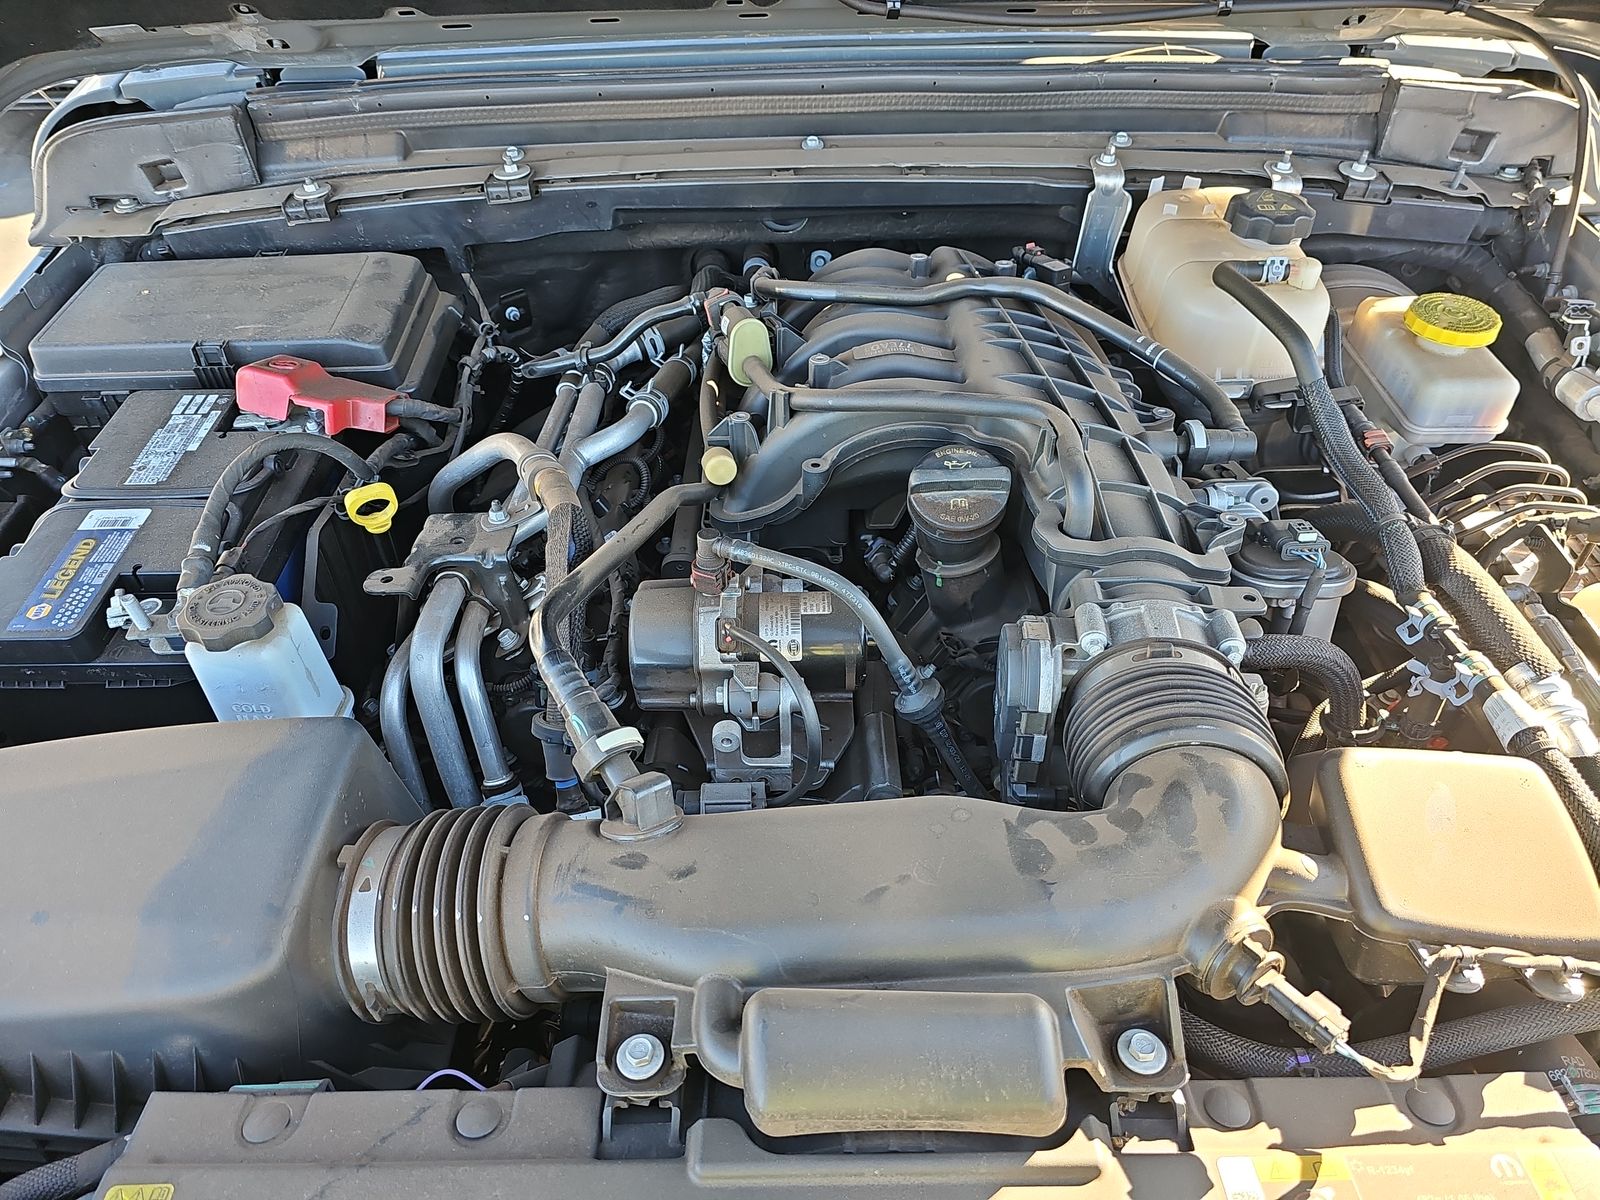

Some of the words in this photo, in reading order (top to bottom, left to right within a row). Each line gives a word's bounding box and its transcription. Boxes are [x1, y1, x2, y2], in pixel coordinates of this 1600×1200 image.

[935, 447, 964, 458] ENGINE
[966, 449, 979, 458] OIL
[940, 513, 956, 522] SAE
[41, 538, 97, 600] LEGEND
[232, 703, 271, 713] COLD
[1561, 1056, 1586, 1066] RAD
